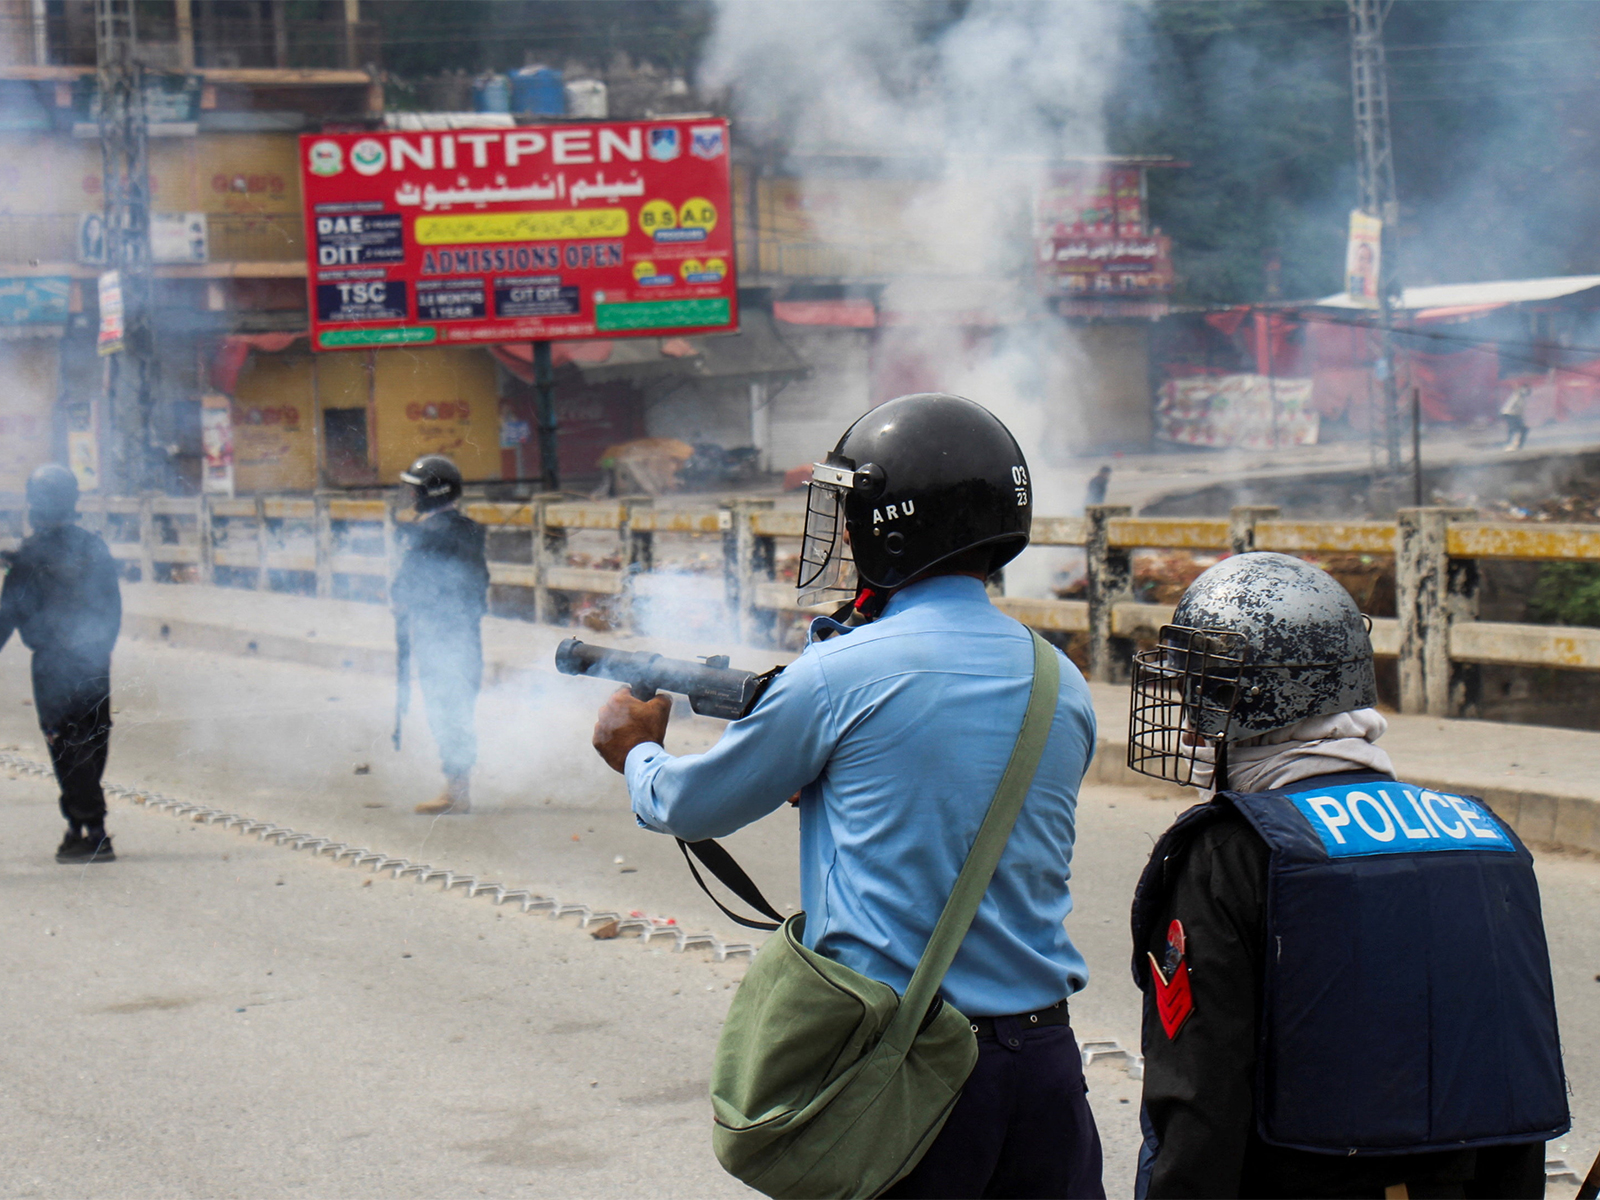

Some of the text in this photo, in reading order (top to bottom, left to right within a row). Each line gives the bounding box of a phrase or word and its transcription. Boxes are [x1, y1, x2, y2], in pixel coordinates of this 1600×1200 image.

[389, 128, 643, 171] NITPEN
[570, 169, 645, 206] نیلم
[317, 215, 364, 235] DAE
[319, 245, 363, 265] DIT
[422, 246, 560, 274] ADMISSIONS
[564, 242, 624, 270] OPEN
[336, 281, 387, 304] TSC
[1016, 492, 1028, 507] 23
[872, 500, 915, 524] ARU
[1306, 790, 1497, 844] POLICE
